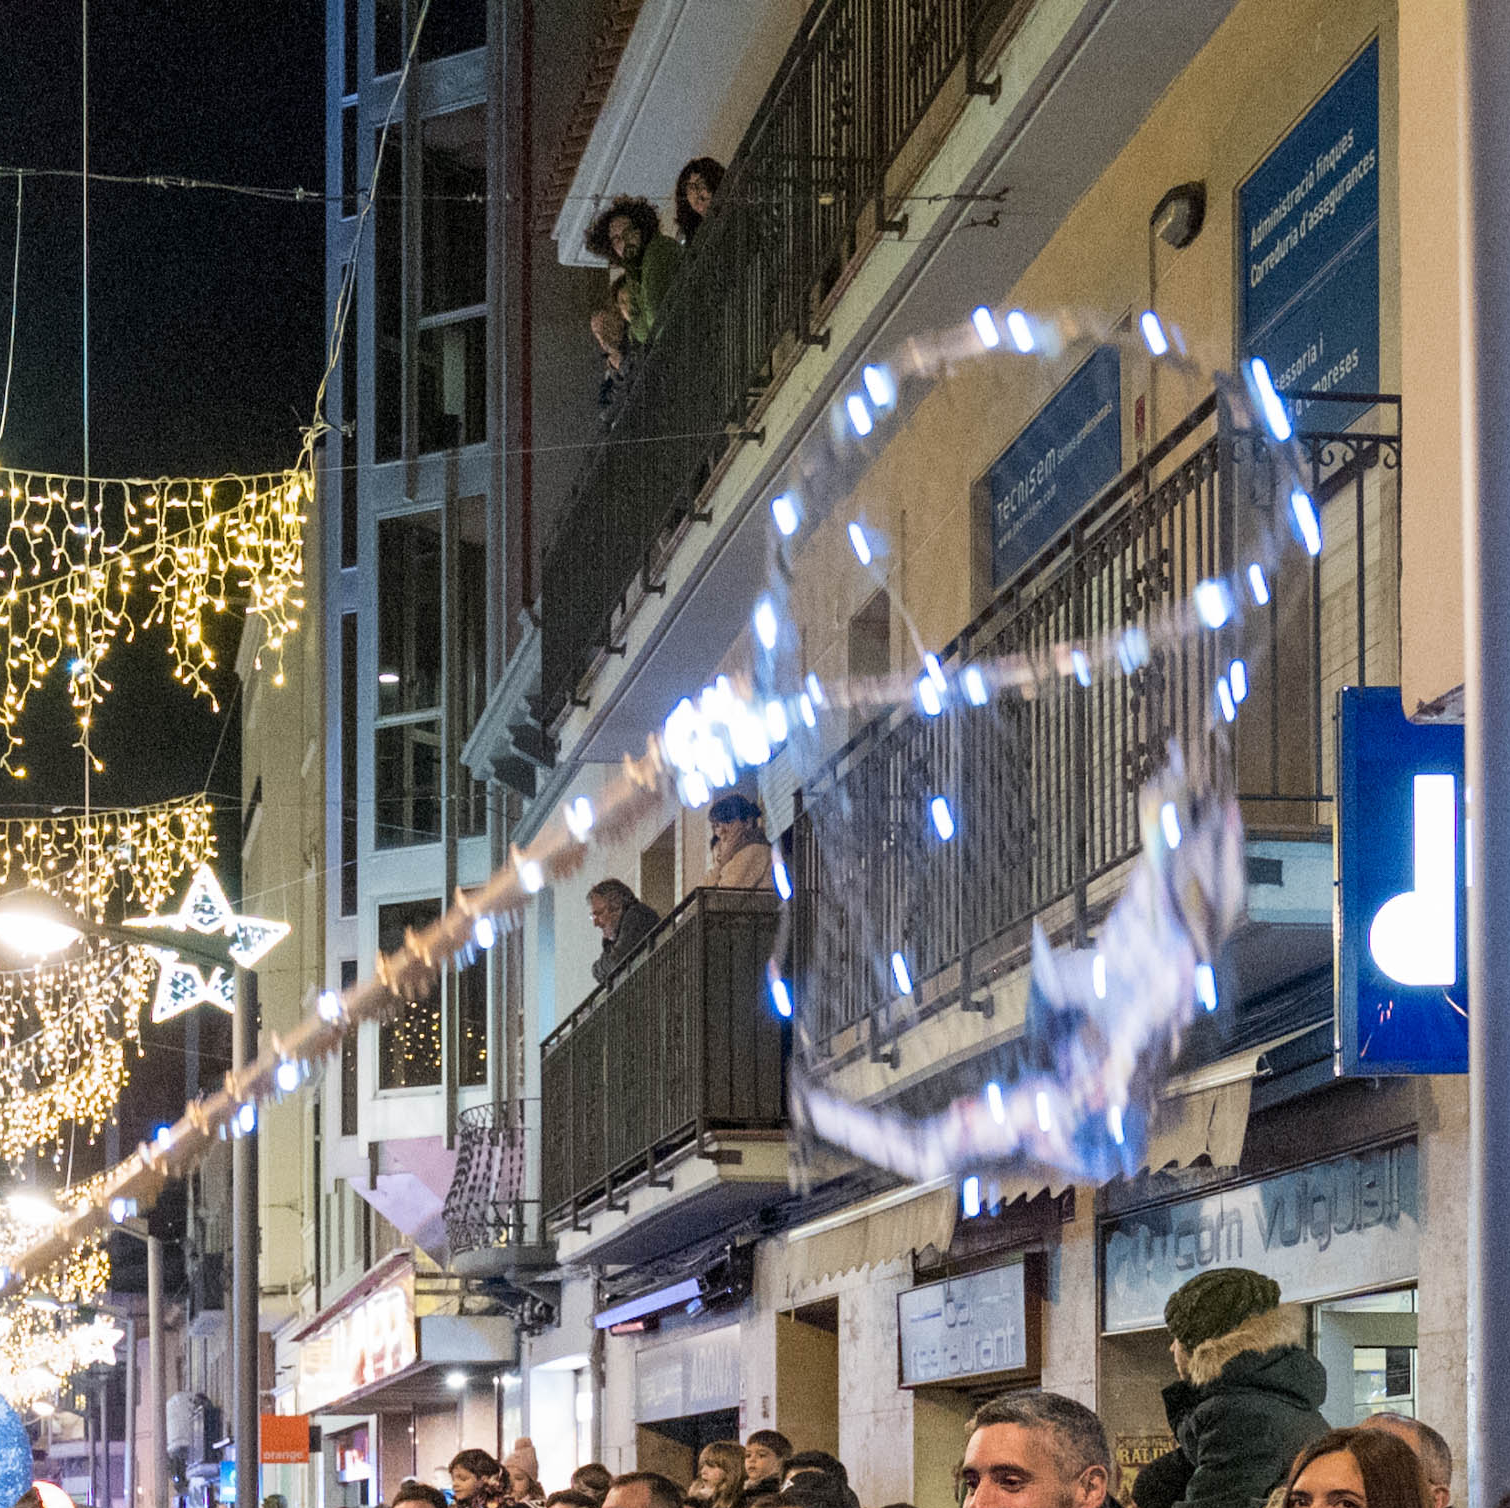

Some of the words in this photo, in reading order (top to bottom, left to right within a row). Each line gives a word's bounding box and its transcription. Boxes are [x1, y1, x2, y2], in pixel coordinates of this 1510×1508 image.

[1250, 162, 1315, 251] Administració
[1316, 127, 1354, 180] finques
[1250, 227, 1298, 288] Correduria
[1300, 149, 1375, 239] d'assegurances
